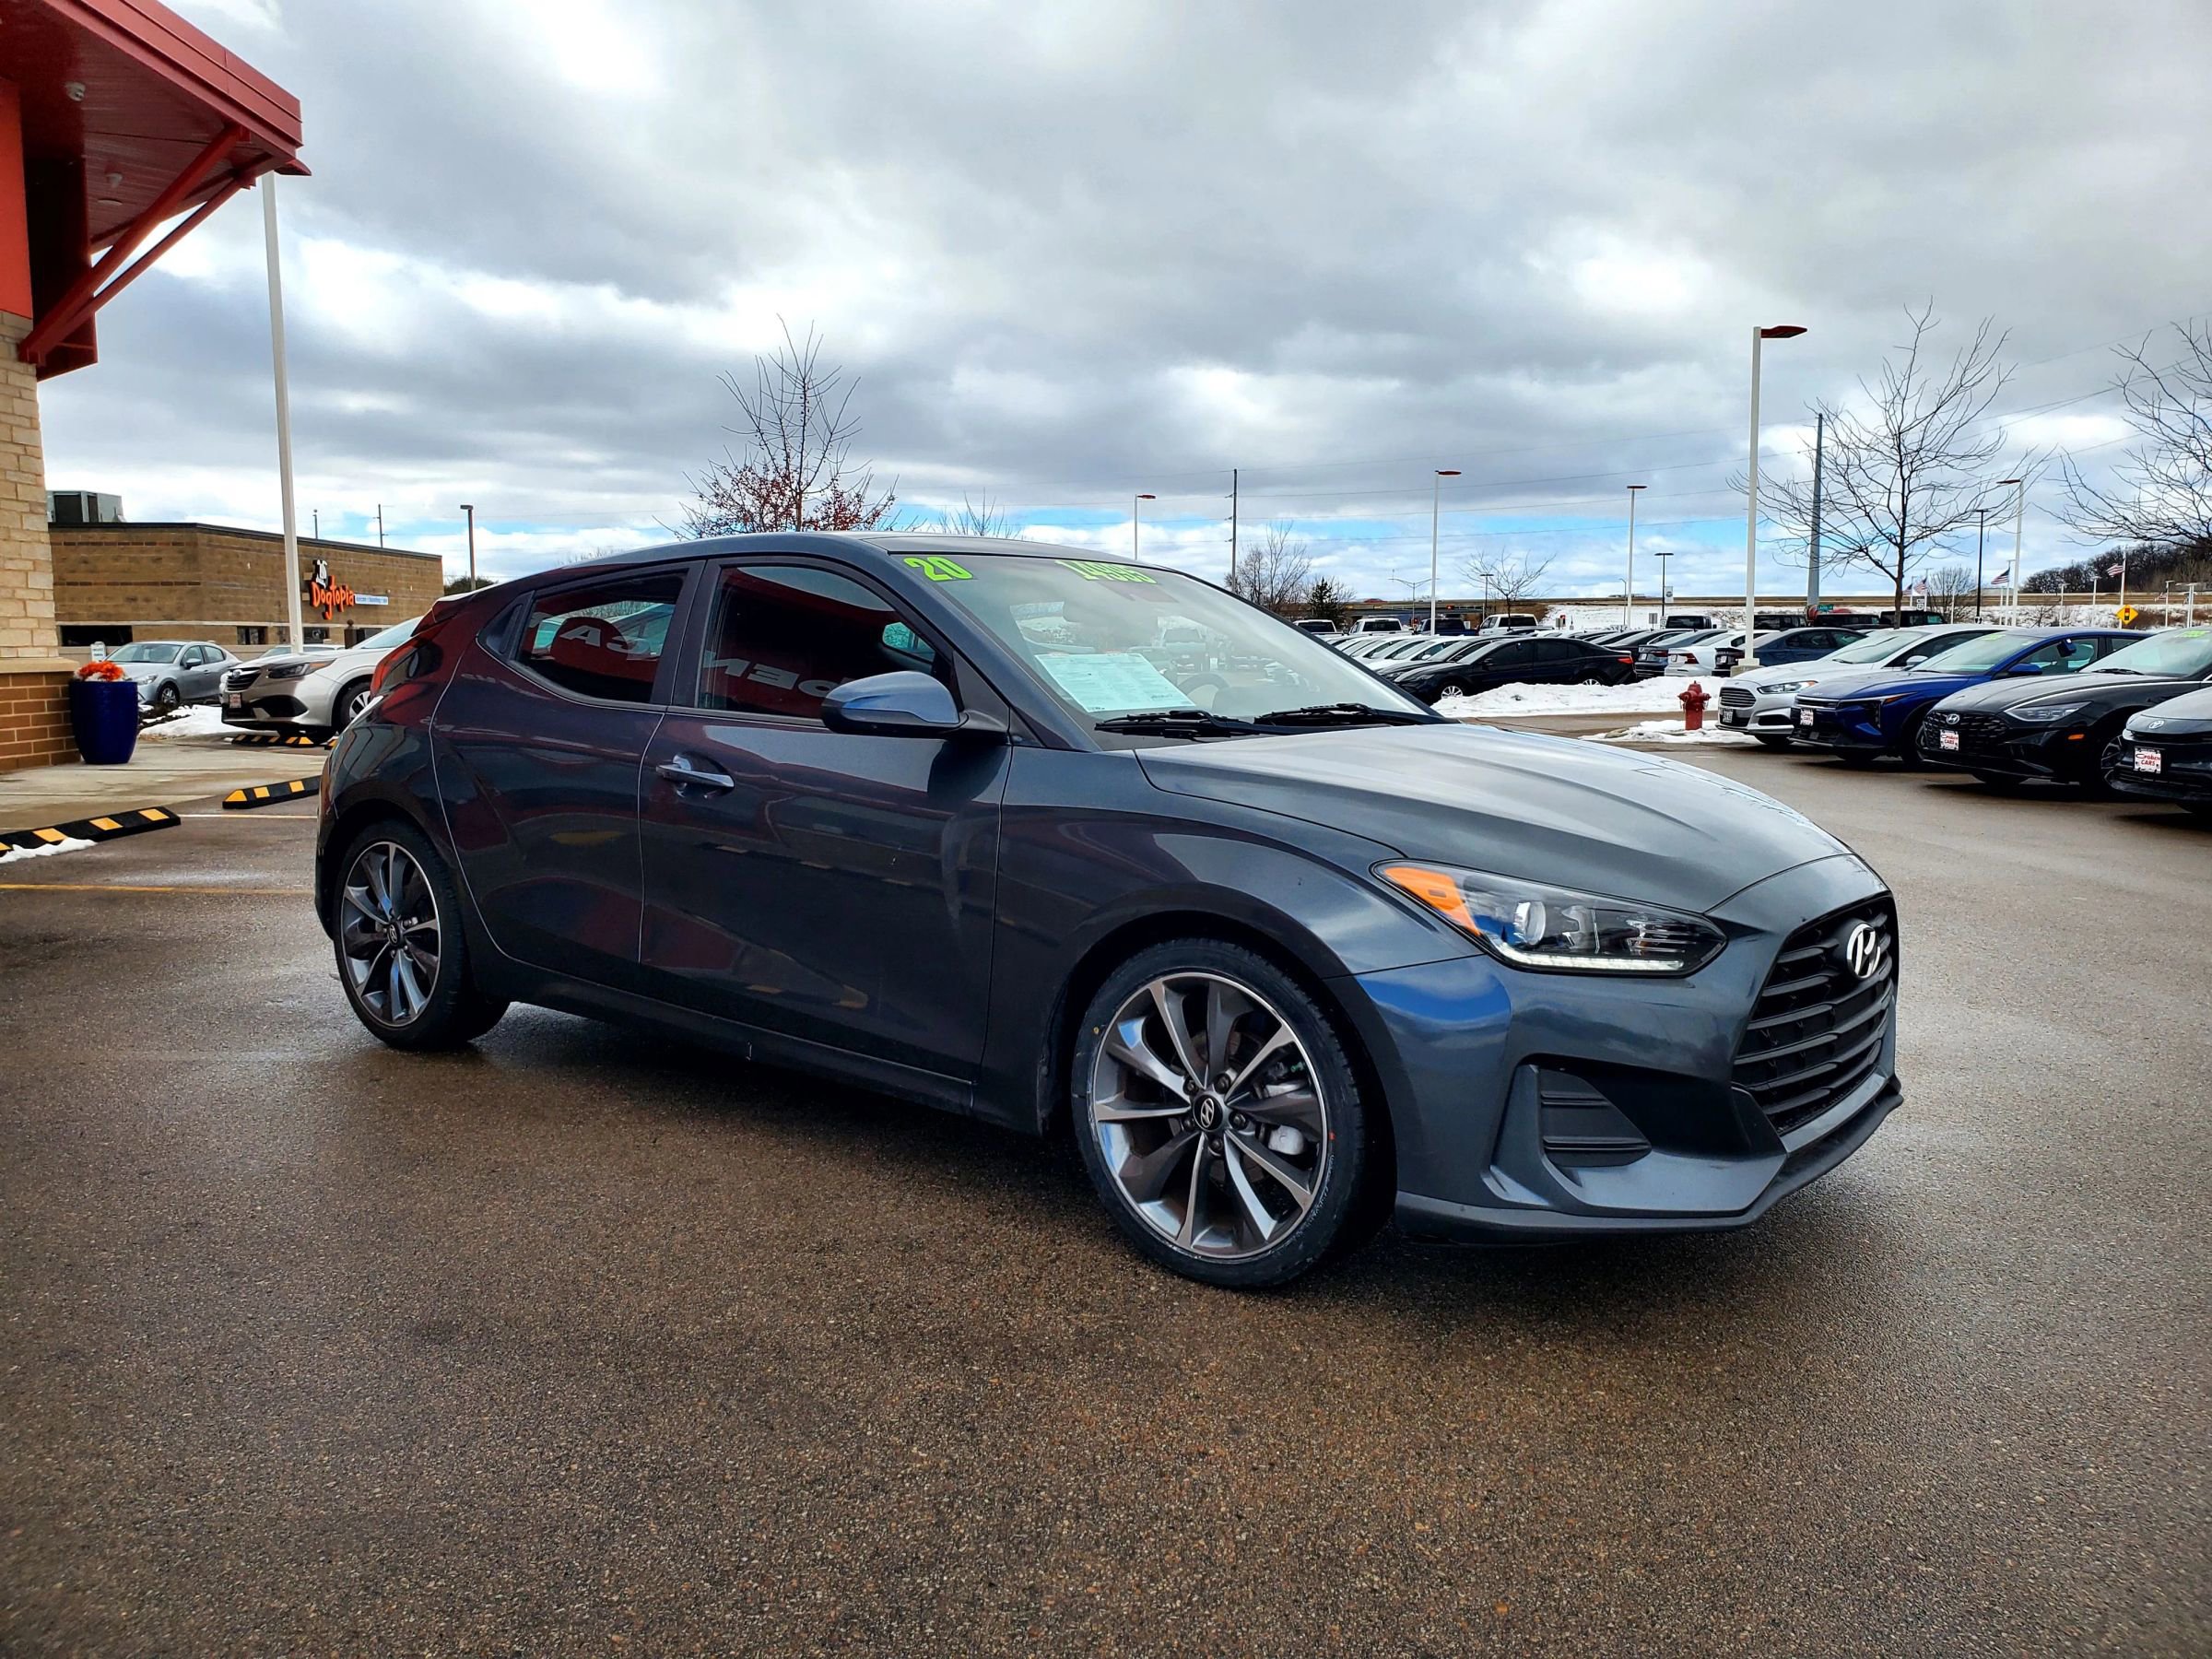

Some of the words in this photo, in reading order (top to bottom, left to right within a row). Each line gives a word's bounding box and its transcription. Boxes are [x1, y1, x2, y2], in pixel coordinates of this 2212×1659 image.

[904, 557, 973, 582] 20
[311, 574, 355, 620] Dogtopia
[2140, 759, 2156, 767] CARS
